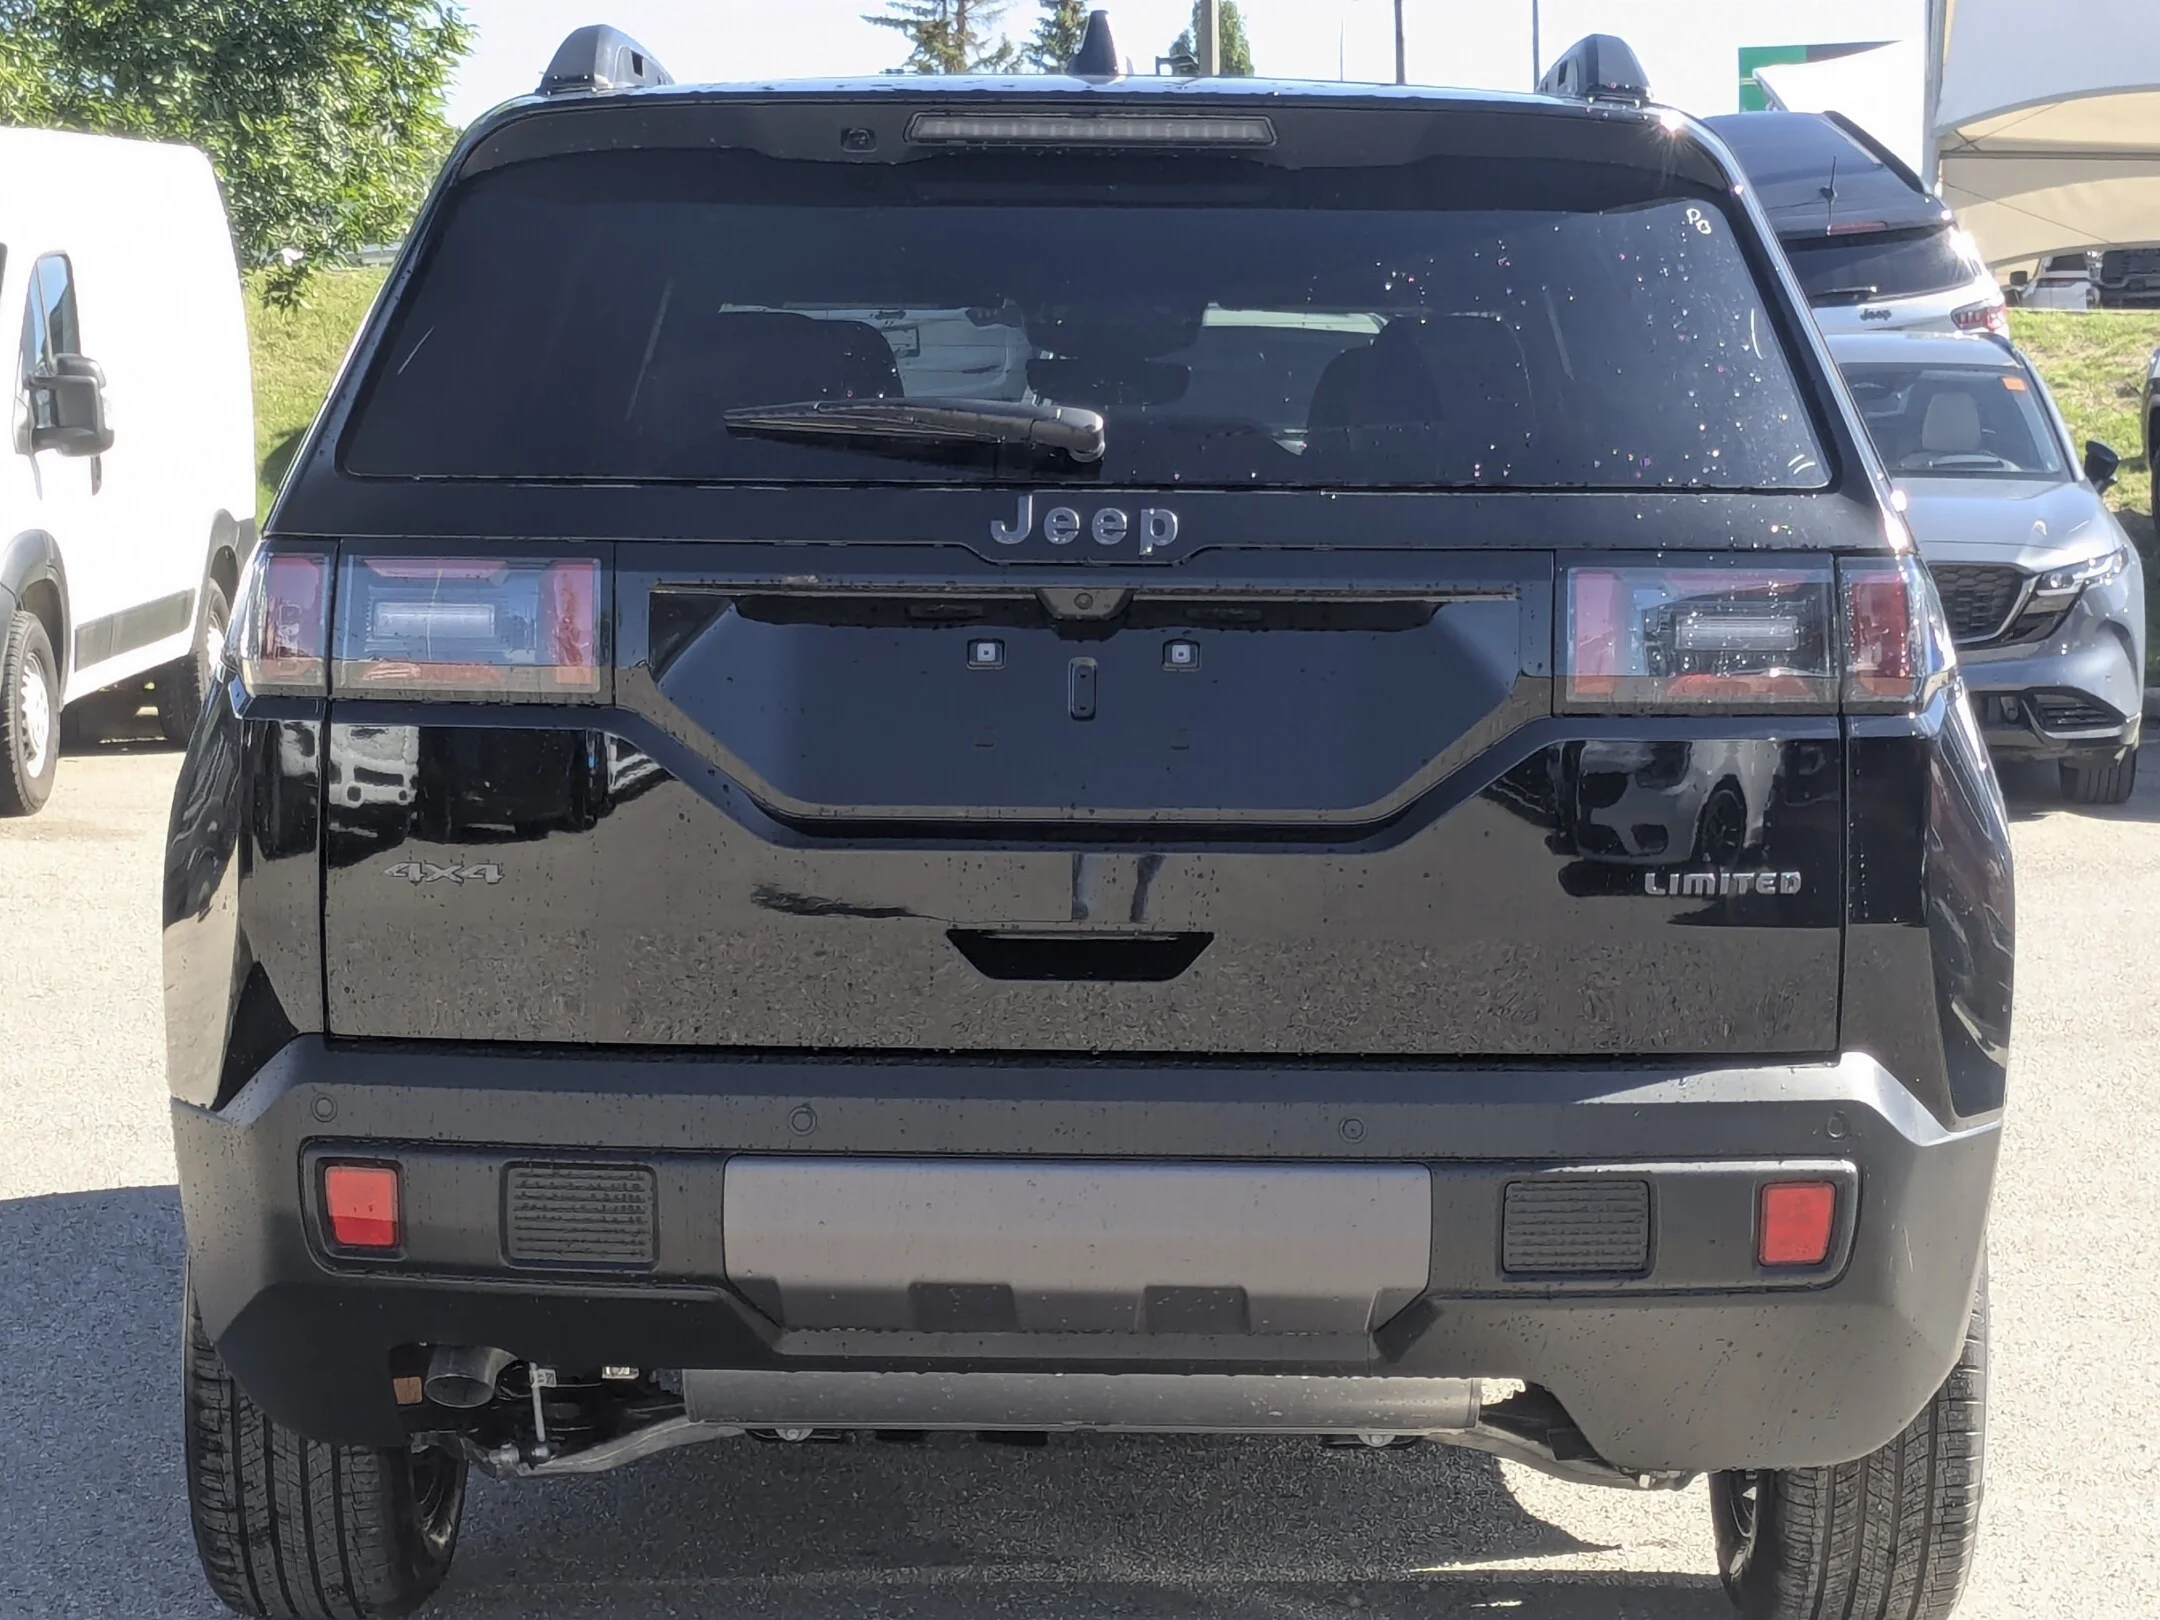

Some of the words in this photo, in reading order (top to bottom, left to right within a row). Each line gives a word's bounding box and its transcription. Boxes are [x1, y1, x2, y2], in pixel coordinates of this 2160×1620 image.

[1859, 308, 1892, 321] Jeep
[990, 495, 1178, 555] Jeep
[1645, 871, 1802, 896] LIMITED
